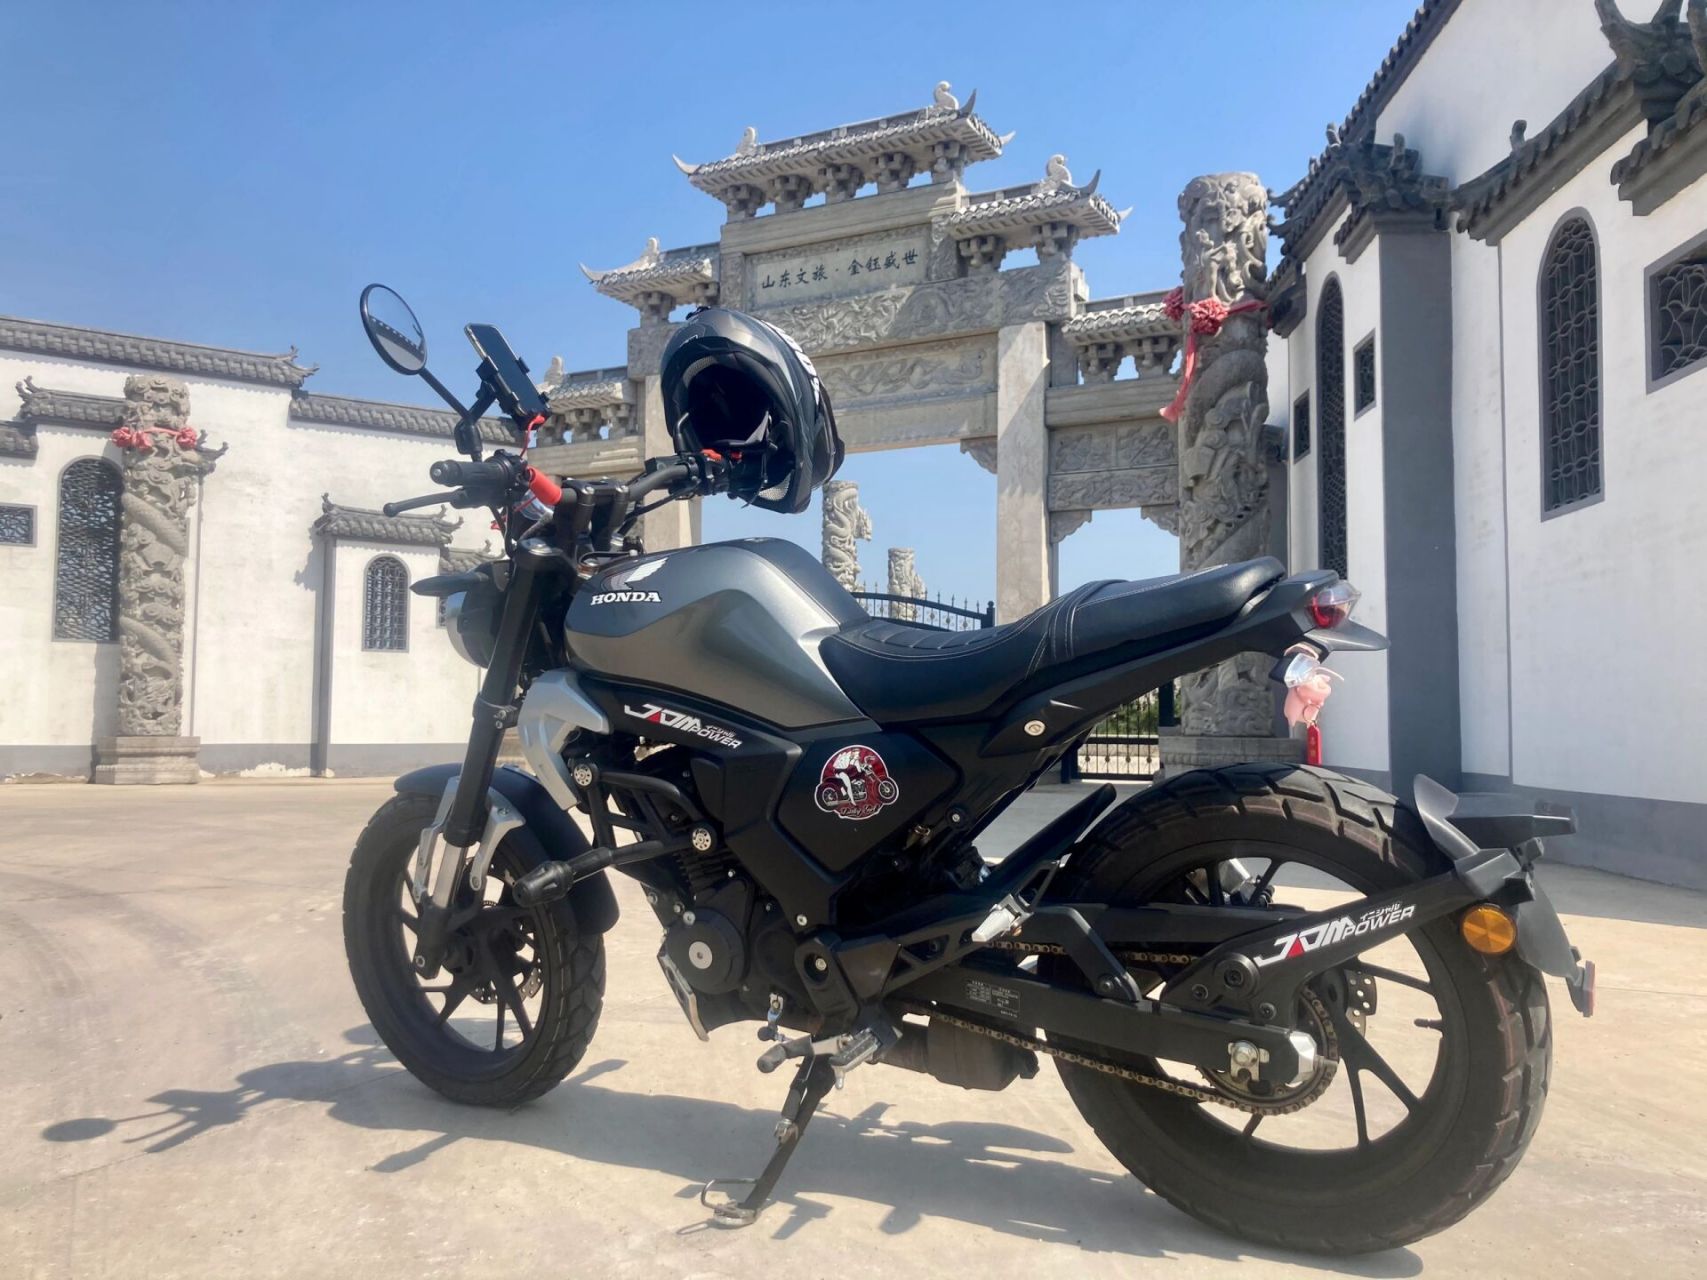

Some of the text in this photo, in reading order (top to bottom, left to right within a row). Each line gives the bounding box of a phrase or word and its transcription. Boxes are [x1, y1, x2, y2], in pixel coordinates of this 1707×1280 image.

[590, 591, 662, 606] HONDA
[687, 727, 743, 749] POWER
[1342, 905, 1417, 940] POWER
